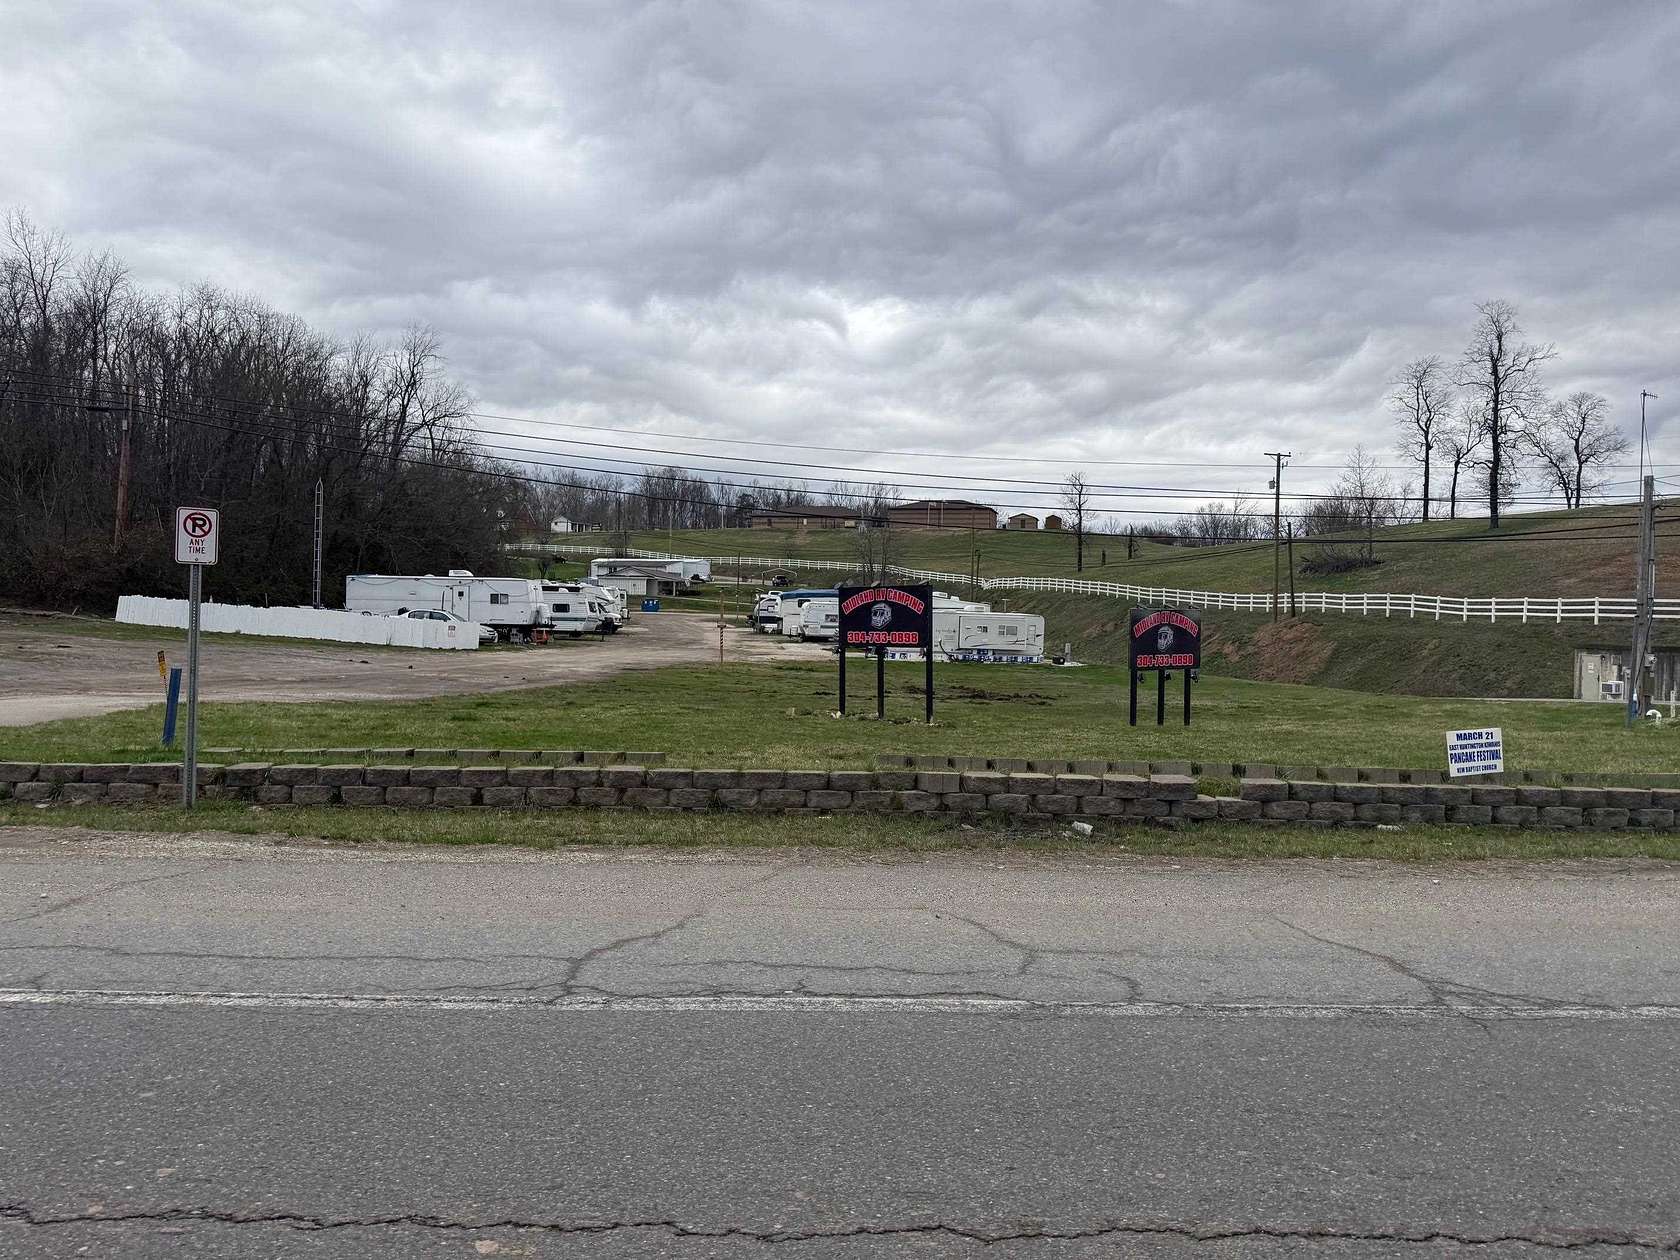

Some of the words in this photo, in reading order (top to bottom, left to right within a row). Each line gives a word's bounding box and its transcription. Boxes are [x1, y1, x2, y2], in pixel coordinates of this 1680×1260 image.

[189, 538, 205, 547] ANY
[188, 546, 206, 555] TIME
[841, 588, 875, 615] MIDLAND
[875, 587, 887, 601] RV
[886, 588, 925, 615] CAMPING
[1170, 611, 1199, 637] CAMPING
[1455, 731, 1484, 741] MARCH
[1485, 731, 1494, 740] 21
[1449, 751, 1476, 764] PANCAKE
[1476, 749, 1502, 762] FESTIVAL
